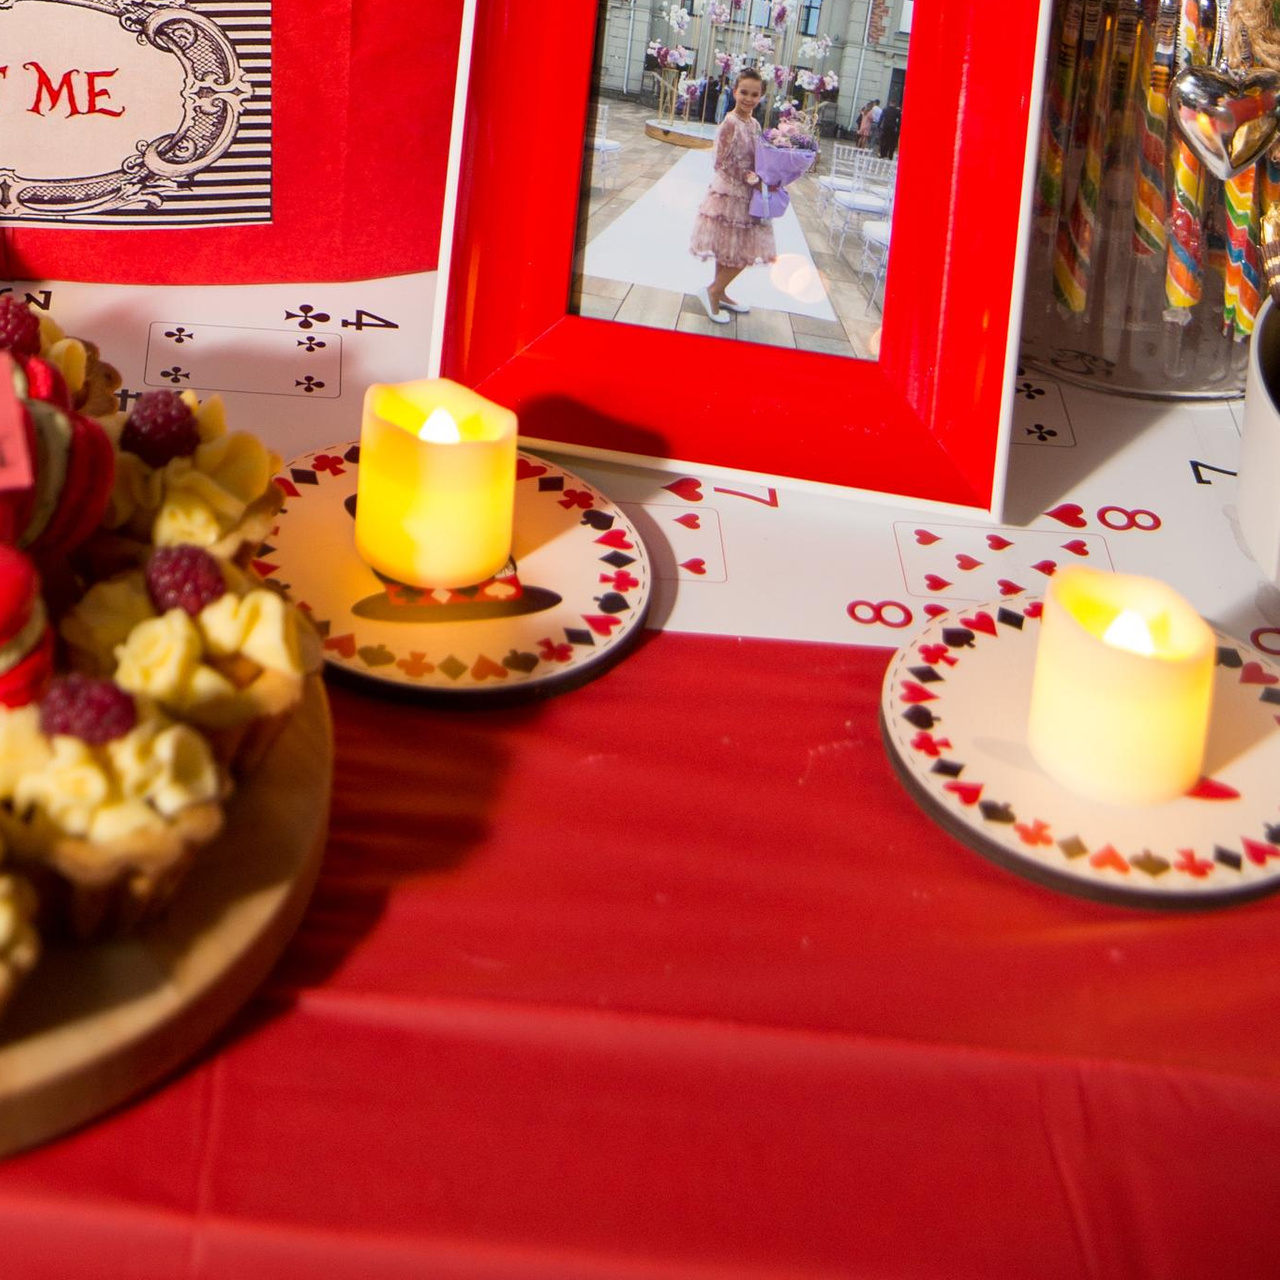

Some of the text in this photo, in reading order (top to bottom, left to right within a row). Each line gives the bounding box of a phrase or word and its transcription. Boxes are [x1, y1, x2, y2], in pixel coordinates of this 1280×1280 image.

[22, 60, 126, 119] ME
[340, 308, 400, 332] 4
[1096, 504, 1163, 532] 8
[845, 598, 914, 629] 8
